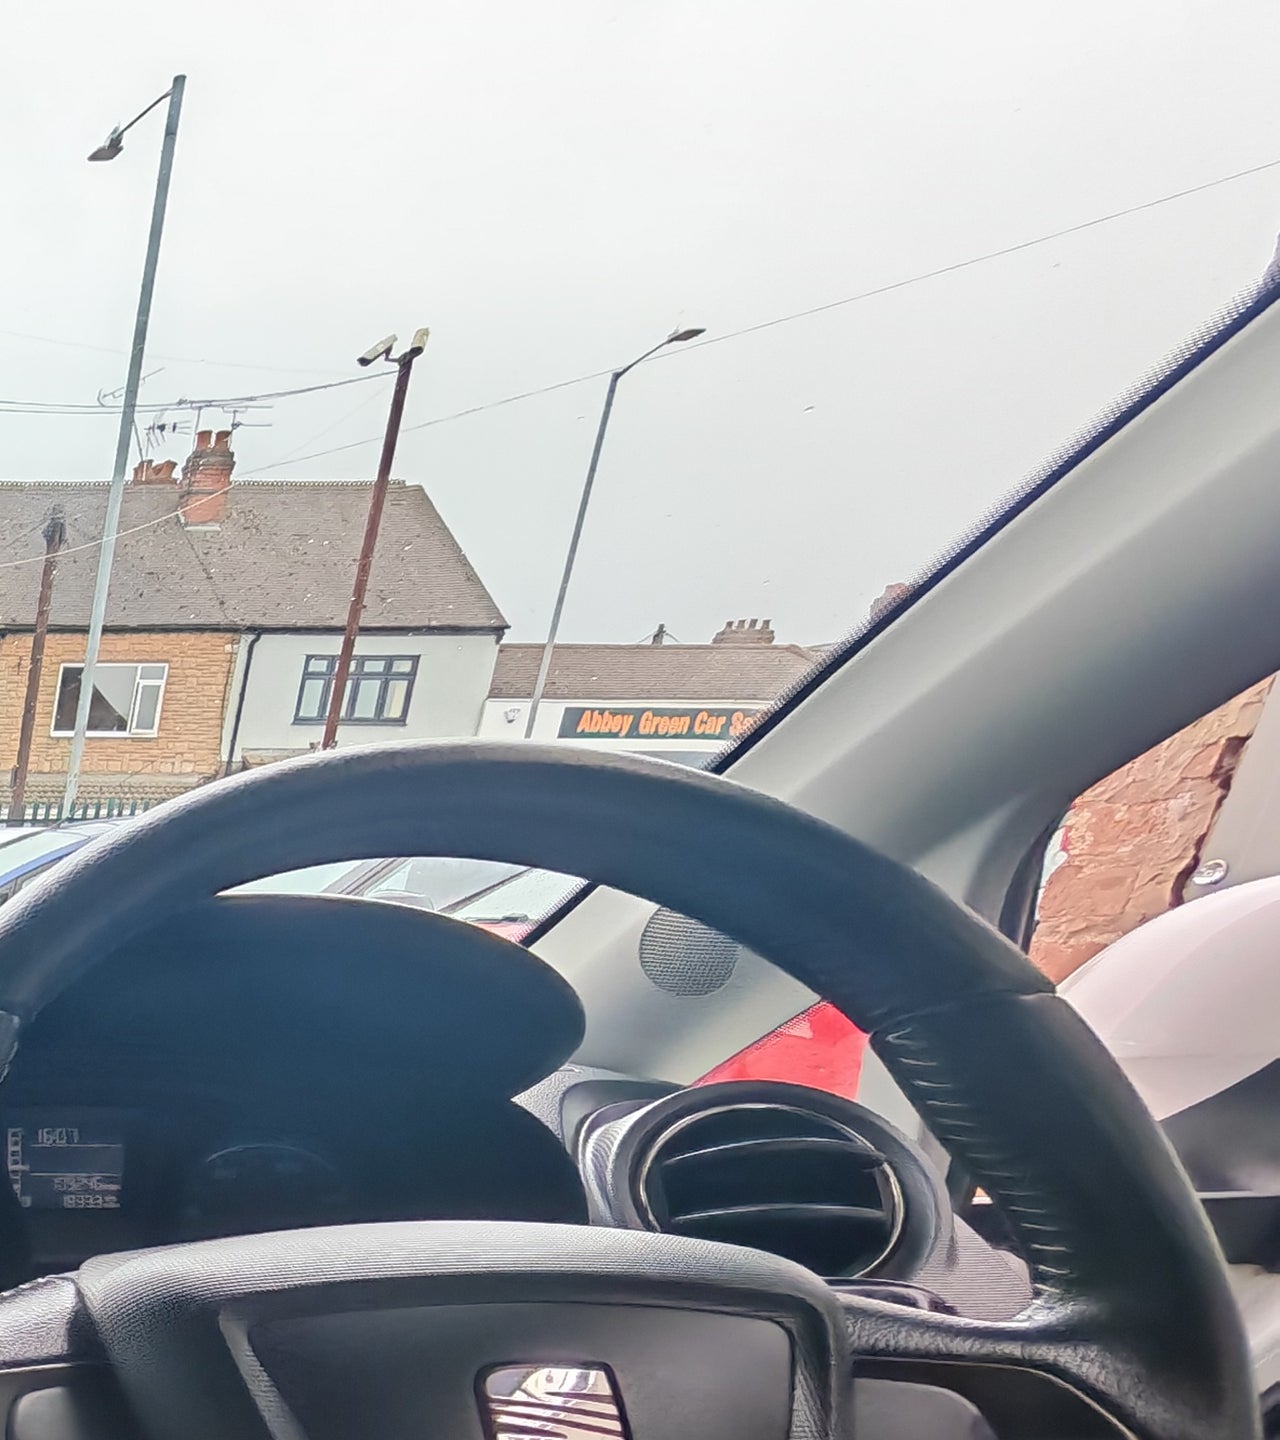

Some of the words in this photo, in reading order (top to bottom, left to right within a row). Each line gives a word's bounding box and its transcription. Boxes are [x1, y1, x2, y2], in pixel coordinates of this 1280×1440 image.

[576, 709, 634, 737] Abbey
[638, 710, 691, 736] Green
[693, 710, 727, 736] Car
